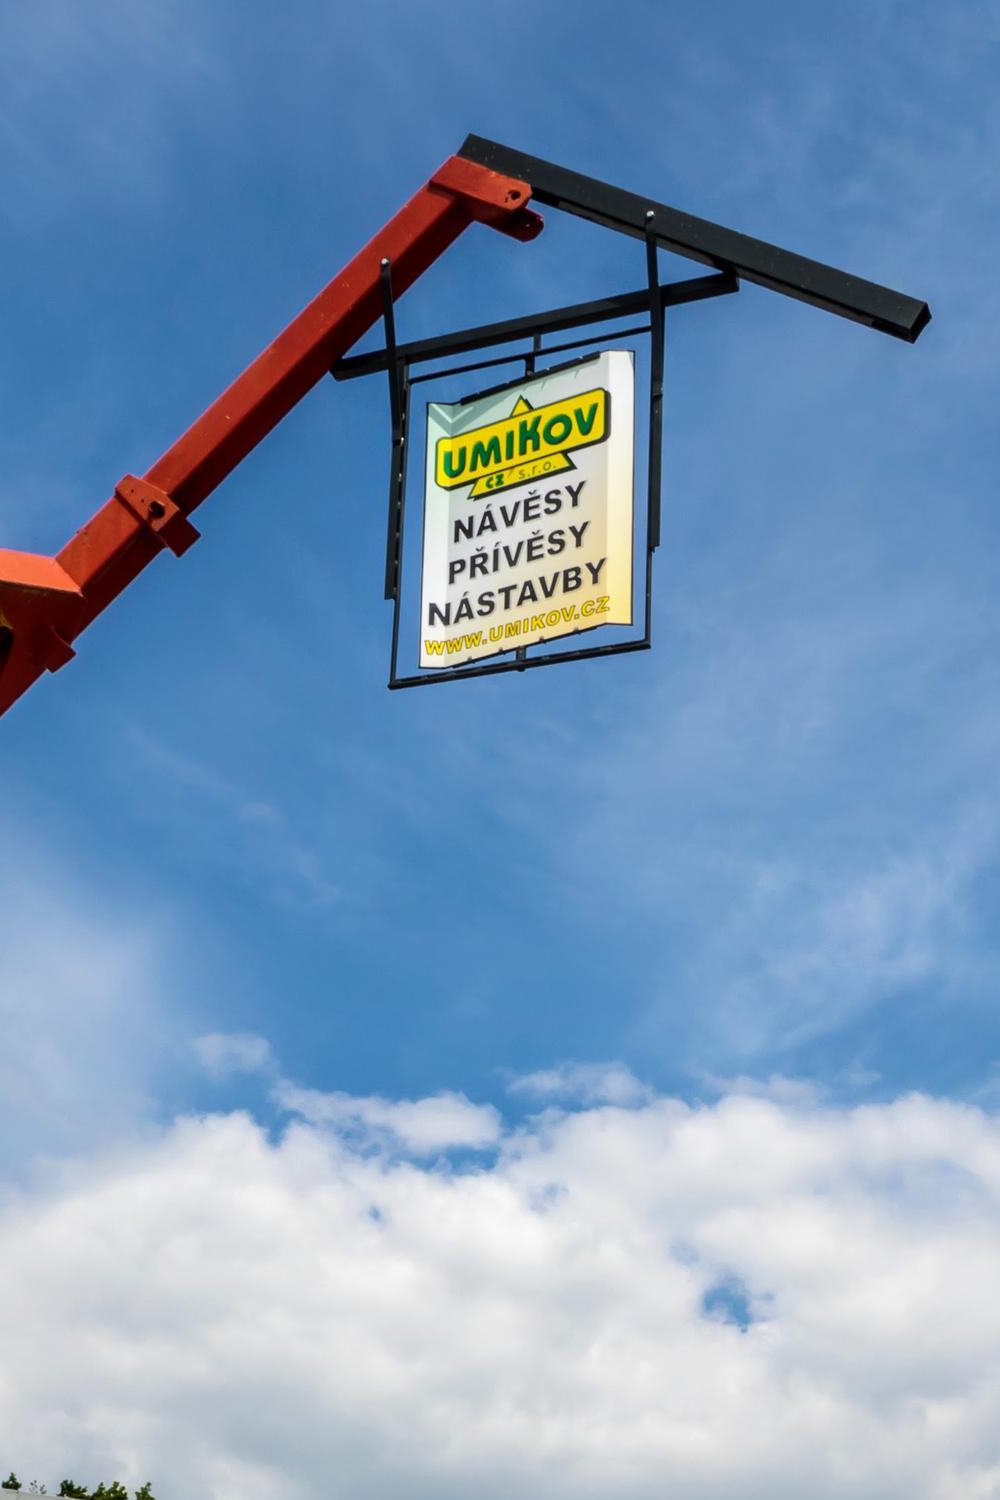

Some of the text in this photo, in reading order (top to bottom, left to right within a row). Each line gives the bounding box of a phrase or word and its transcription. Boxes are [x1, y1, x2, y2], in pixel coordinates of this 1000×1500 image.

[443, 402, 599, 478] UMIKOV
[485, 461, 557, 489] CZ s.r.o.
[453, 480, 587, 543] NÁVĚSY
[448, 520, 591, 585] PŘÍVĚSY
[427, 558, 607, 627] NÁSTAVBY
[424, 596, 610, 656] WWW.UMIKOV.CZ
